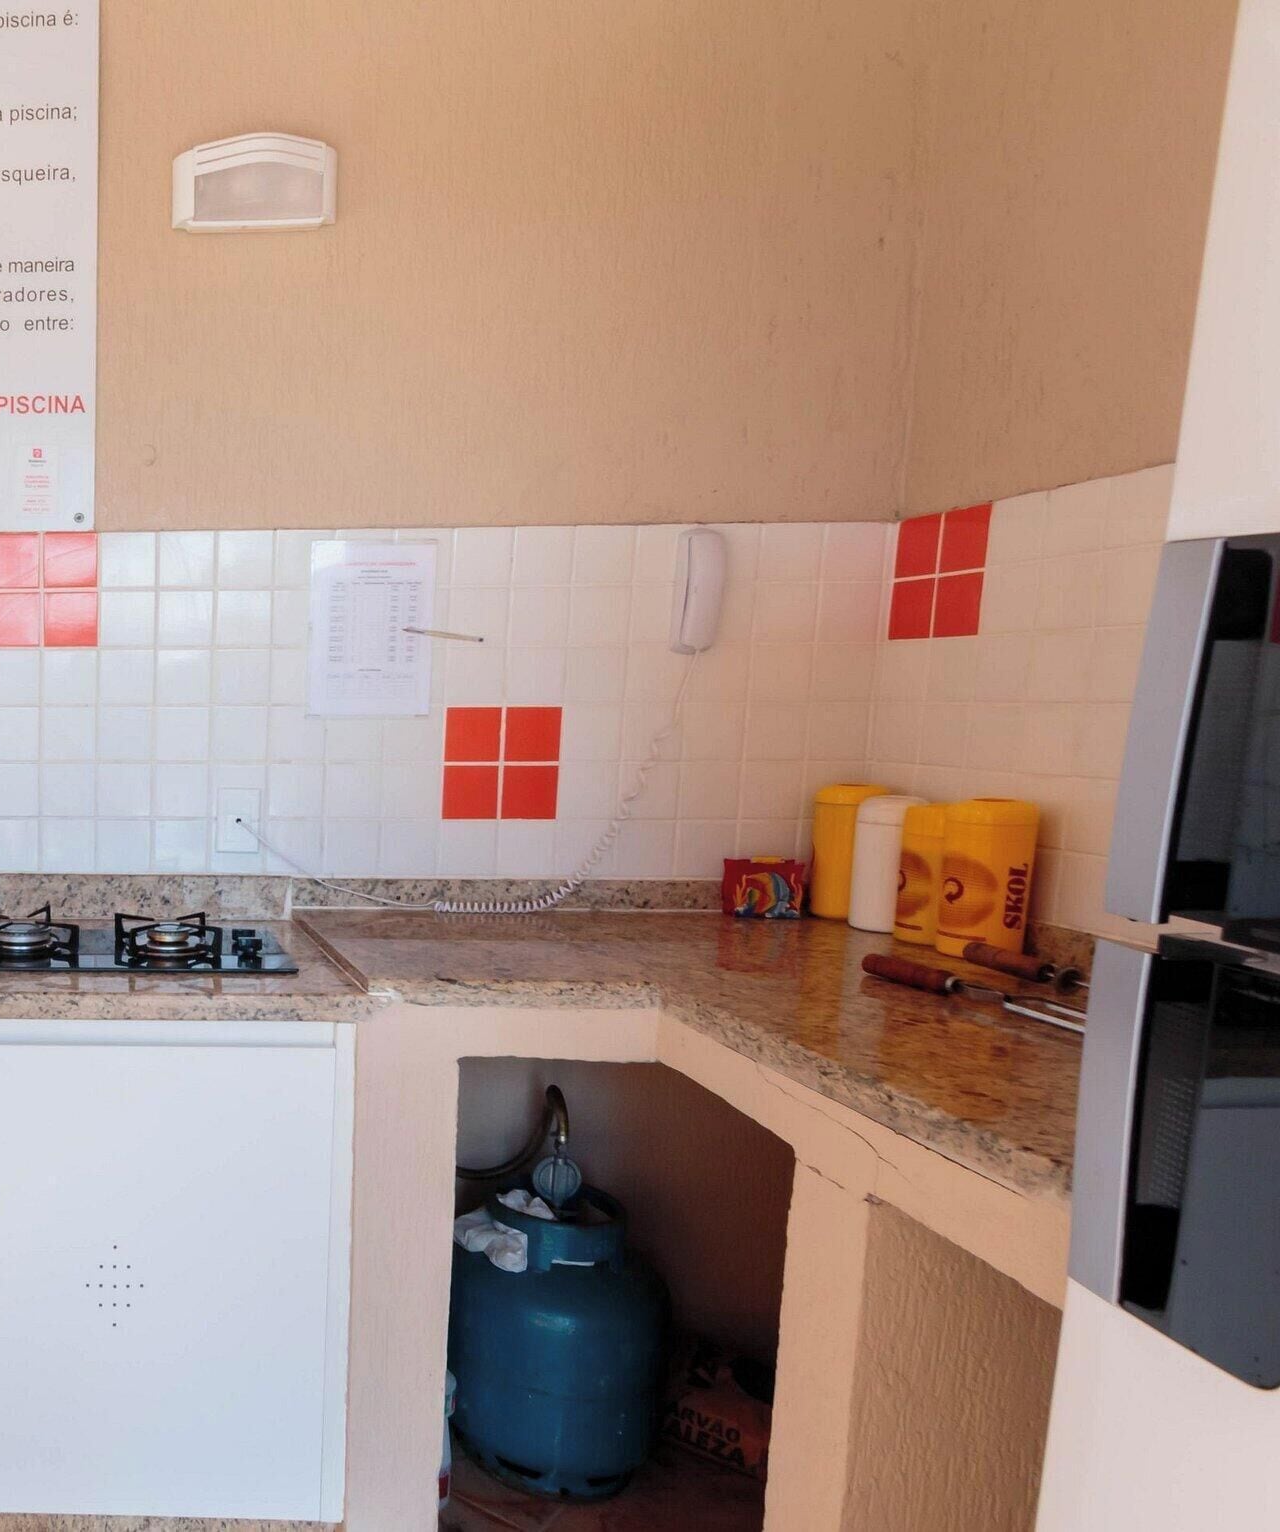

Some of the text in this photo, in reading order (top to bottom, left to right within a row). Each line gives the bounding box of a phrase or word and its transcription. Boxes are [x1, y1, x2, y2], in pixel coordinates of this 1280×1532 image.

[63, 10, 78, 25] é:
[10, 104, 77, 126] piscina;
[9, 258, 74, 272] maneira
[24, 316, 73, 331] entre:
[1003, 863, 1028, 930] SKOL
